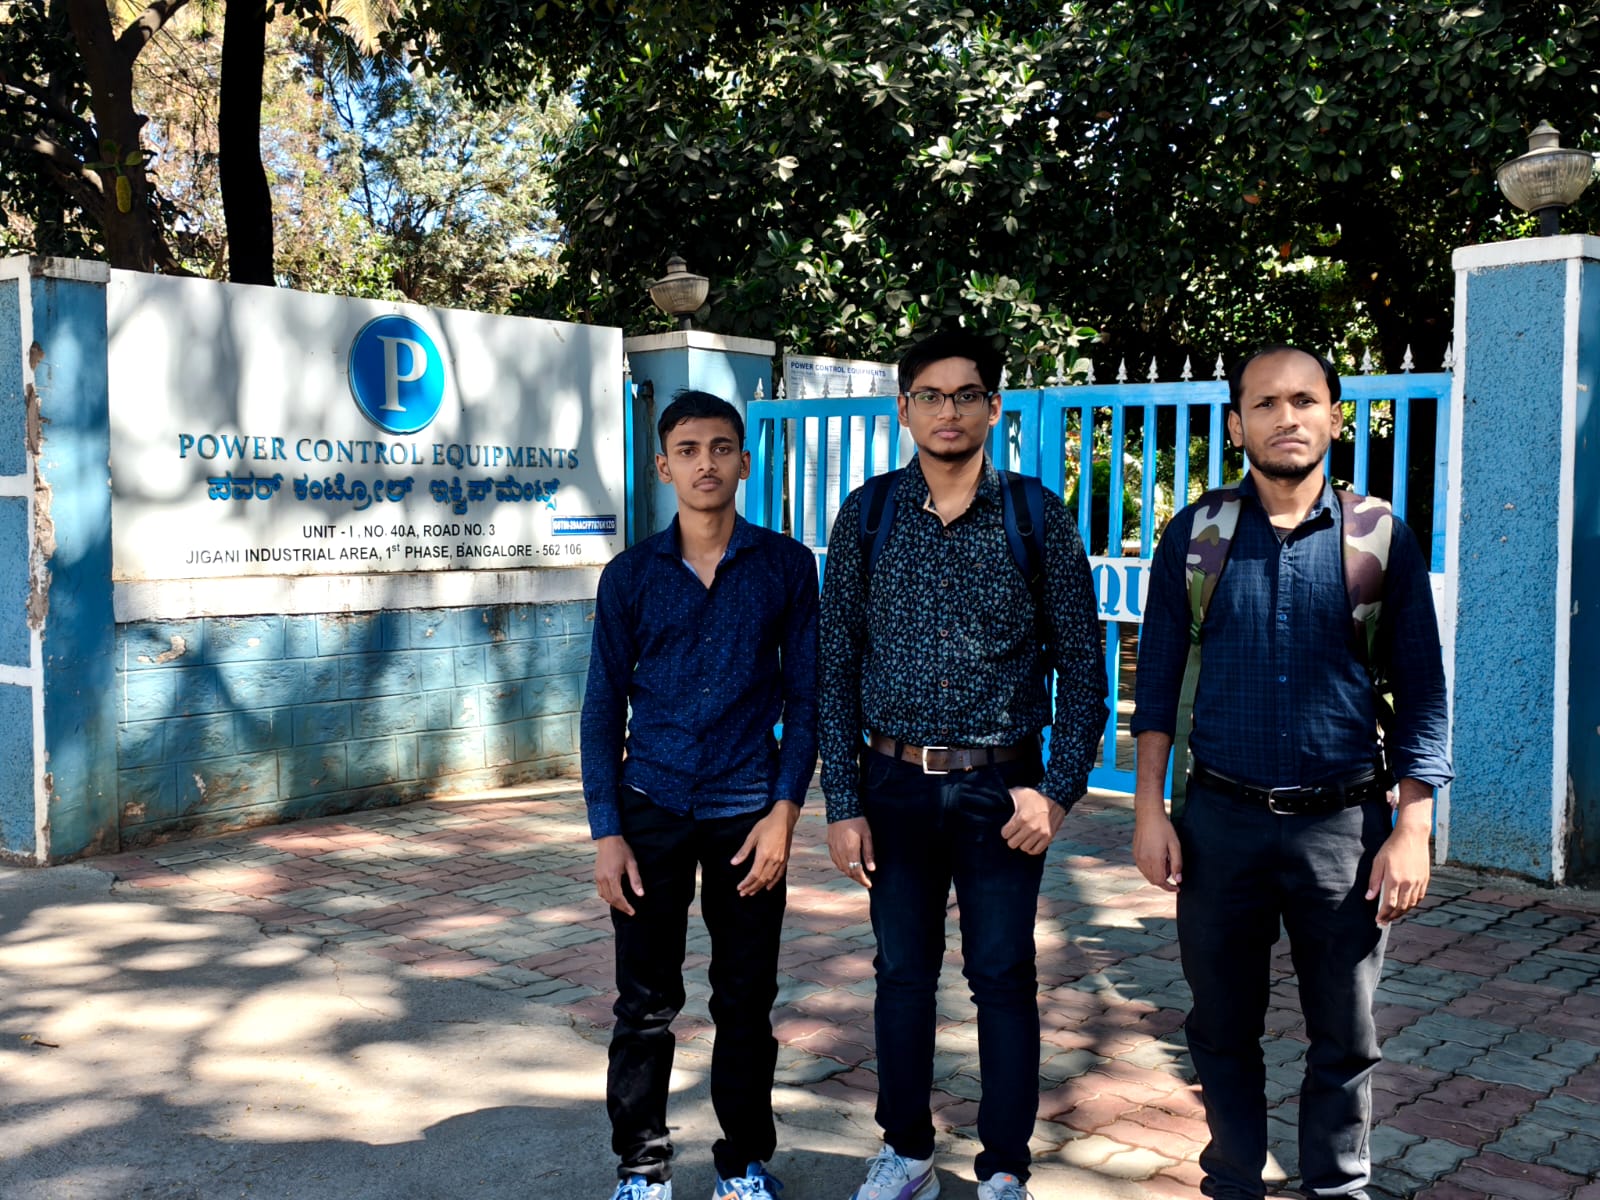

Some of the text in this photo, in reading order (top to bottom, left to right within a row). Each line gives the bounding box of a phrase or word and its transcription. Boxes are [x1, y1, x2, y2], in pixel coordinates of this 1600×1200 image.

[376, 335, 428, 412] P
[790, 361, 814, 370] POWER
[815, 364, 846, 374] CONTROL
[847, 367, 887, 377] EQUIPMENTS
[178, 433, 579, 470] POWER CONTROL EQUIPMENTS
[303, 525, 337, 539] UNIT
[364, 525, 388, 538] NO.
[390, 525, 420, 539] 40A,
[423, 524, 460, 537] ROAD
[464, 524, 485, 536] NO.
[489, 524, 496, 536] 3
[186, 550, 240, 564] JIGANI
[245, 548, 336, 562] INDUSTRIAL
[340, 547, 383, 562] AREA,
[385, 543, 401, 559] 1st
[404, 545, 452, 560] PHASE,
[456, 544, 532, 558] BANGALORE
[542, 543, 561, 556] 562
[565, 543, 582, 555] 106
